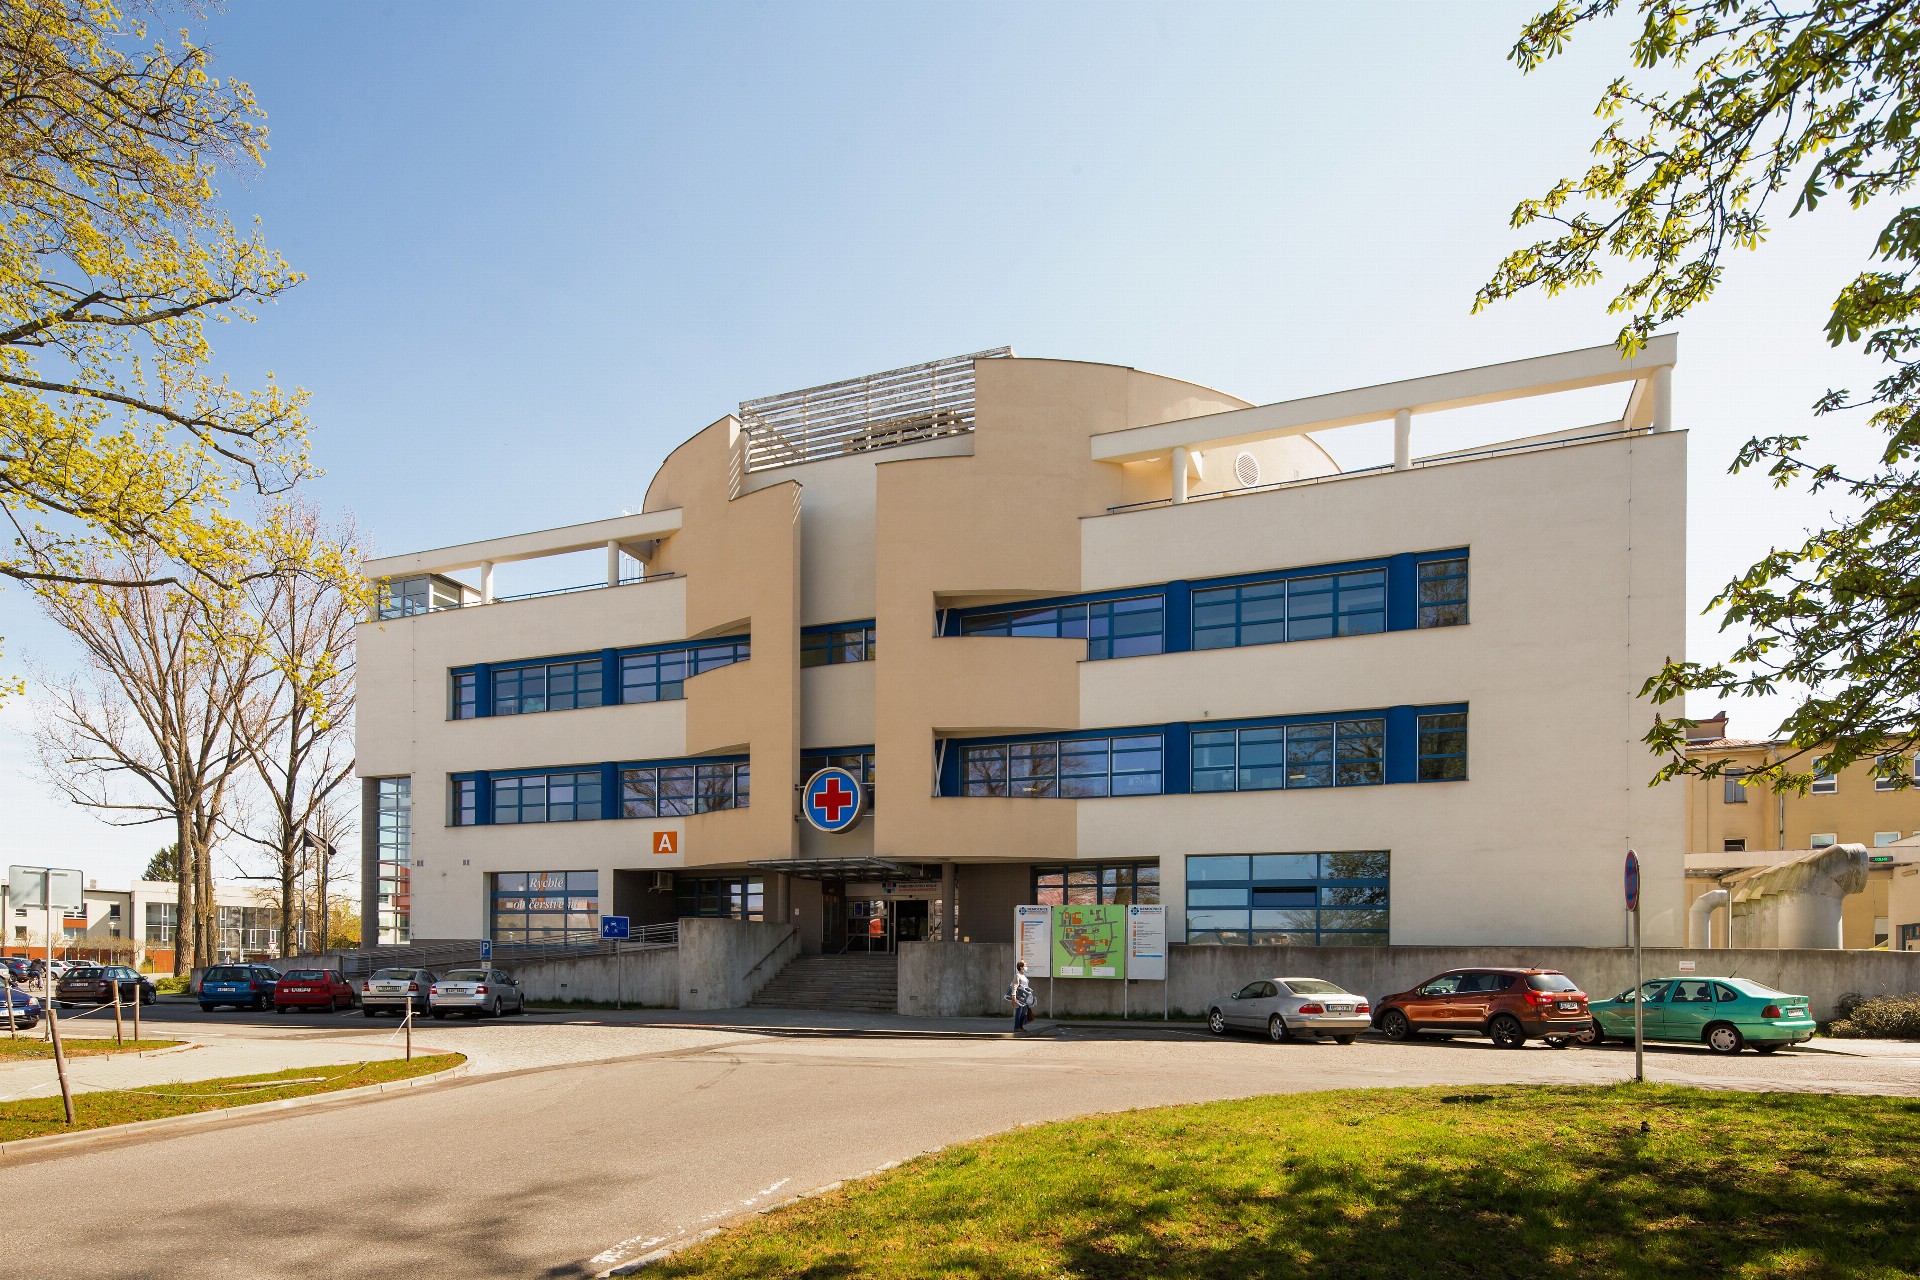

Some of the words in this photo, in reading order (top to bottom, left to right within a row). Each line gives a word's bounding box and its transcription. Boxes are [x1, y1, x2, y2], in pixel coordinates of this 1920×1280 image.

[658, 833, 673, 852] A
[529, 877, 565, 891] Rychlé
[482, 942, 490, 954] P
